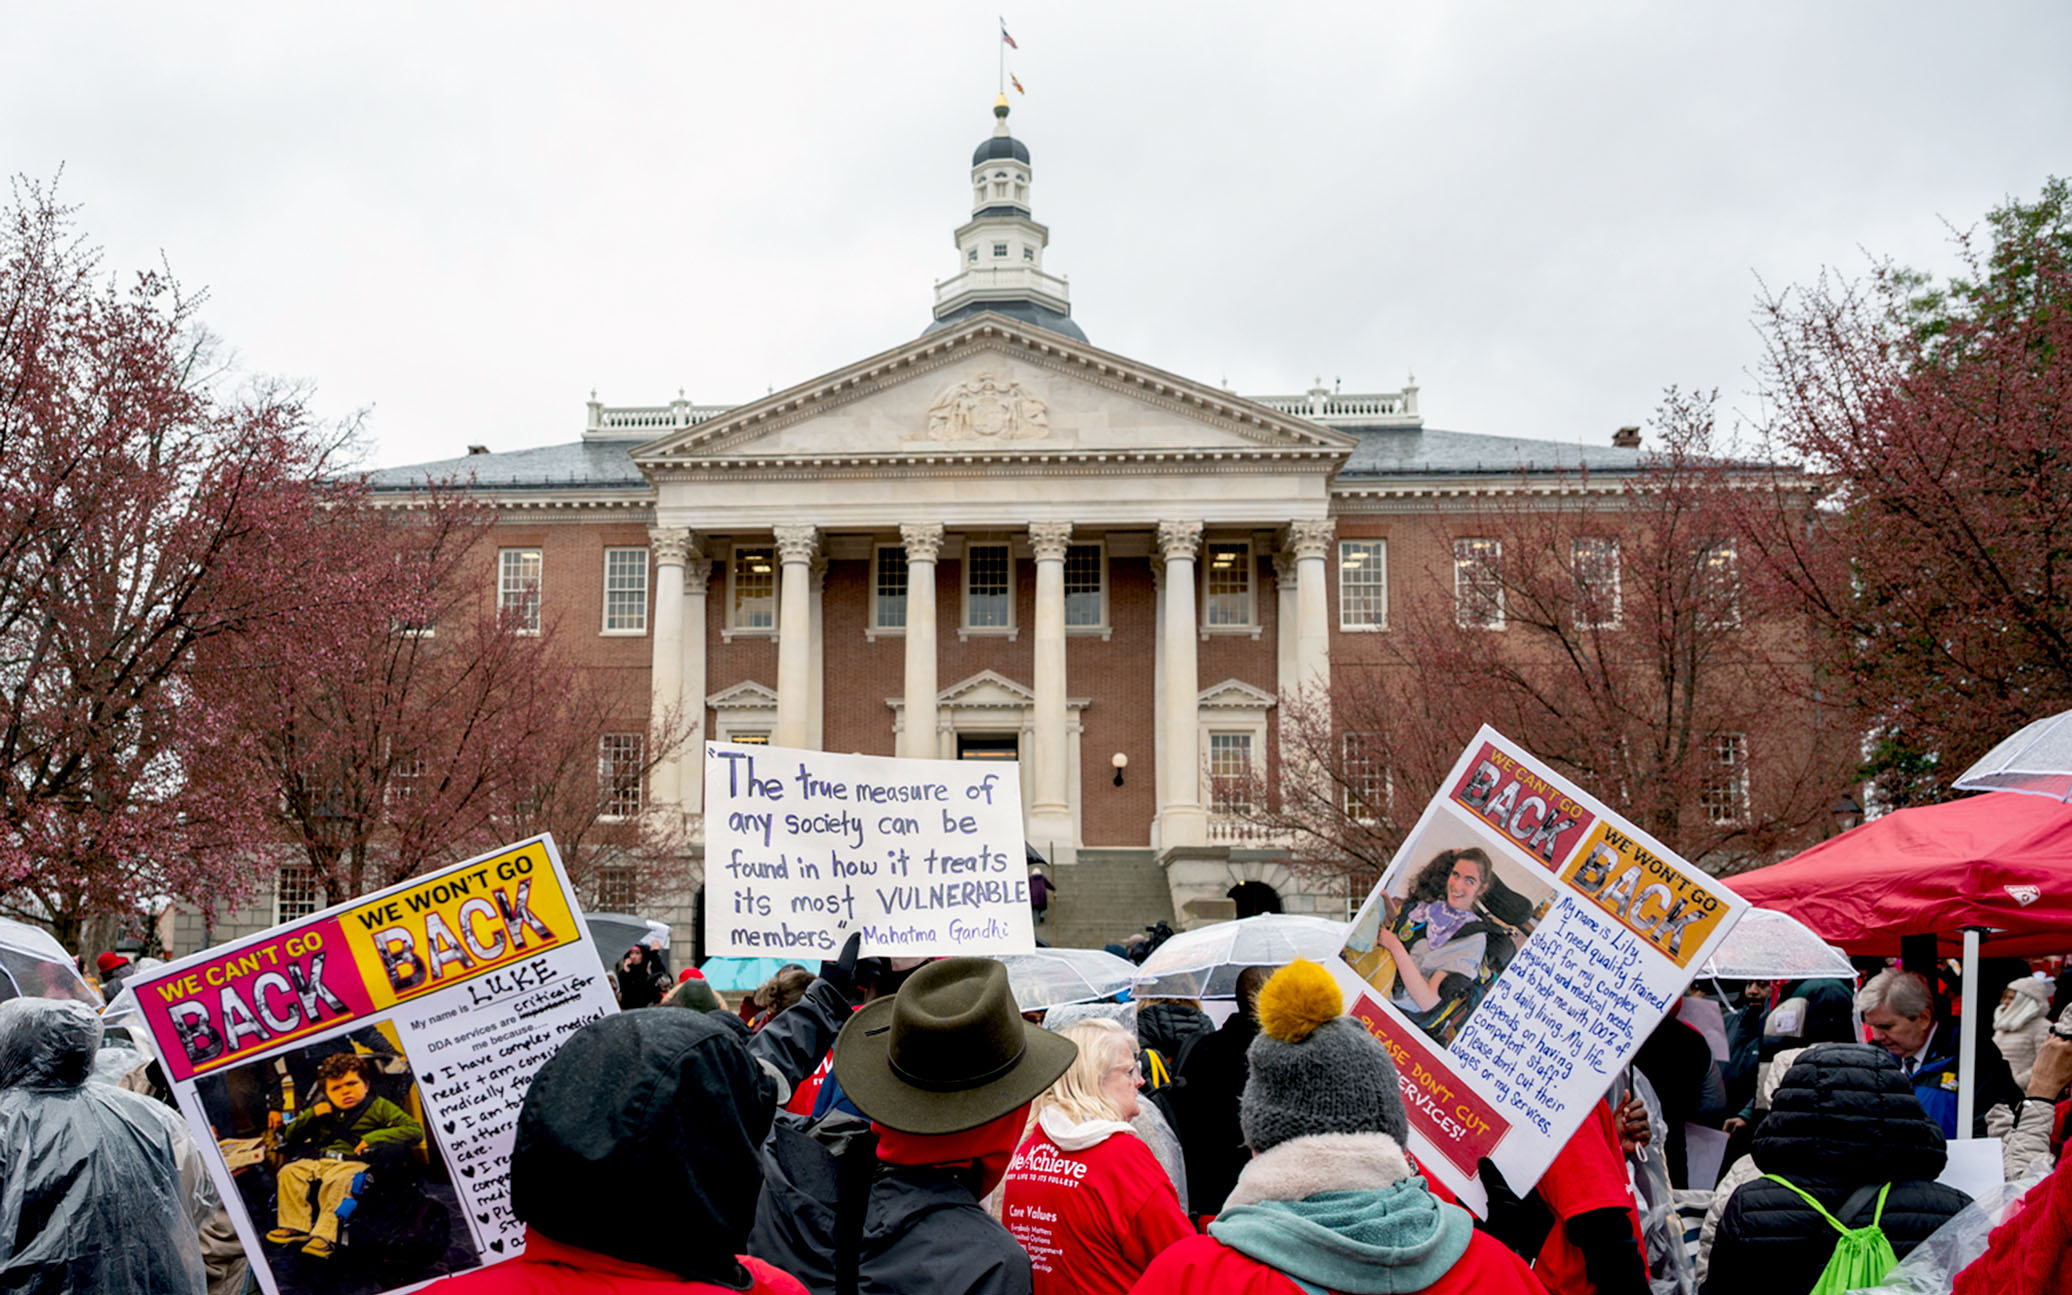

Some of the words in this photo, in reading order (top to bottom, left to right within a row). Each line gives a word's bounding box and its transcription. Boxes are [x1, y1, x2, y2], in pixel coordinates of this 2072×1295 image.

[795, 763, 848, 800] true
[856, 782, 949, 803] measure
[965, 774, 999, 804] of
[1489, 748, 1513, 773] WE
[1513, 763, 1560, 802] CAN'T
[1558, 795, 1584, 819] GO
[728, 811, 772, 847] any
[785, 809, 863, 849] society
[878, 815, 919, 835] can
[942, 808, 978, 834] be
[1460, 759, 1578, 863] BACK
[725, 849, 789, 879] found
[797, 857, 820, 879] in
[831, 850, 877, 878] how
[887, 850, 910, 877] it
[924, 844, 1007, 874] treats
[1603, 826, 1633, 858] WE
[1633, 846, 1691, 892] WON'T
[1689, 887, 1718, 912] GO
[357, 902, 404, 930] WE
[404, 868, 490, 914] WON'T
[496, 855, 534, 882] GO
[734, 887, 771, 916] its
[791, 884, 855, 919] most
[876, 880, 1028, 914] VULNERABLE
[1556, 897, 1576, 920] My
[1574, 907, 1599, 933] name
[1599, 926, 1611, 940] is
[1571, 839, 1709, 958] BACK
[371, 876, 555, 995] BACK
[862, 925, 937, 946] Mahatma
[949, 918, 1009, 942] Gandhi
[156, 974, 204, 1003] WE
[204, 945, 280, 987] CAN'T
[284, 930, 324, 958] GO
[1554, 919, 1567, 938] I
[1565, 931, 1593, 954] need
[1588, 948, 1629, 990] quality
[1629, 971, 1673, 1014] trained
[1560, 948, 1578, 971] for
[1578, 969, 1595, 988] my
[166, 951, 350, 1066] BACK
[410, 1017, 426, 1032] My
[428, 1009, 458, 1025] name
[459, 1004, 469, 1014] is
[467, 958, 558, 1005] LUKE
[514, 984, 570, 1012] critical
[570, 976, 596, 991] for
[1509, 962, 1528, 979] and
[1527, 968, 1537, 986] to
[1534, 975, 1555, 1001] help
[1552, 996, 1568, 1011] me
[1566, 1006, 1589, 1028] with
[1588, 1017, 1619, 1046] 100%
[1615, 1041, 1631, 1059] of
[1554, 972, 1574, 990] and
[1570, 985, 1608, 1016] medical
[427, 1039, 453, 1053] DDA
[454, 1022, 498, 1044] services
[499, 1016, 518, 1029] are
[440, 1066, 457, 1080] I
[457, 1053, 494, 1073] have
[499, 1032, 551, 1057] complex
[556, 1005, 605, 1035] medical
[472, 1039, 489, 1052] me
[1482, 994, 1520, 1032] depends
[1522, 1029, 1537, 1044] on
[1535, 1032, 1574, 1080] having
[1496, 978, 1512, 1000] my
[1513, 986, 1536, 1020] daily
[1562, 1029, 1584, 1058] My
[1583, 1042, 1607, 1075] life
[431, 1081, 471, 1101] needs
[489, 1064, 516, 1081] am
[1450, 1042, 1481, 1072] wages
[1481, 1068, 1495, 1081] or
[1494, 1079, 1511, 1103] my
[1459, 1025, 1494, 1060] Please
[1535, 1086, 1565, 1113] their
[439, 1085, 504, 1117] medically
[461, 1116, 476, 1129] I
[480, 1107, 502, 1122] am
[1396, 1069, 1467, 1142] ERVICES!
[1411, 1063, 1455, 1104] DON'T
[1455, 1104, 1491, 1137] CUT
[450, 1138, 468, 1151] on
[478, 1161, 491, 1175] I
[1047, 1175, 1080, 1189] FULLEST
[1026, 1205, 1057, 1223] Values
